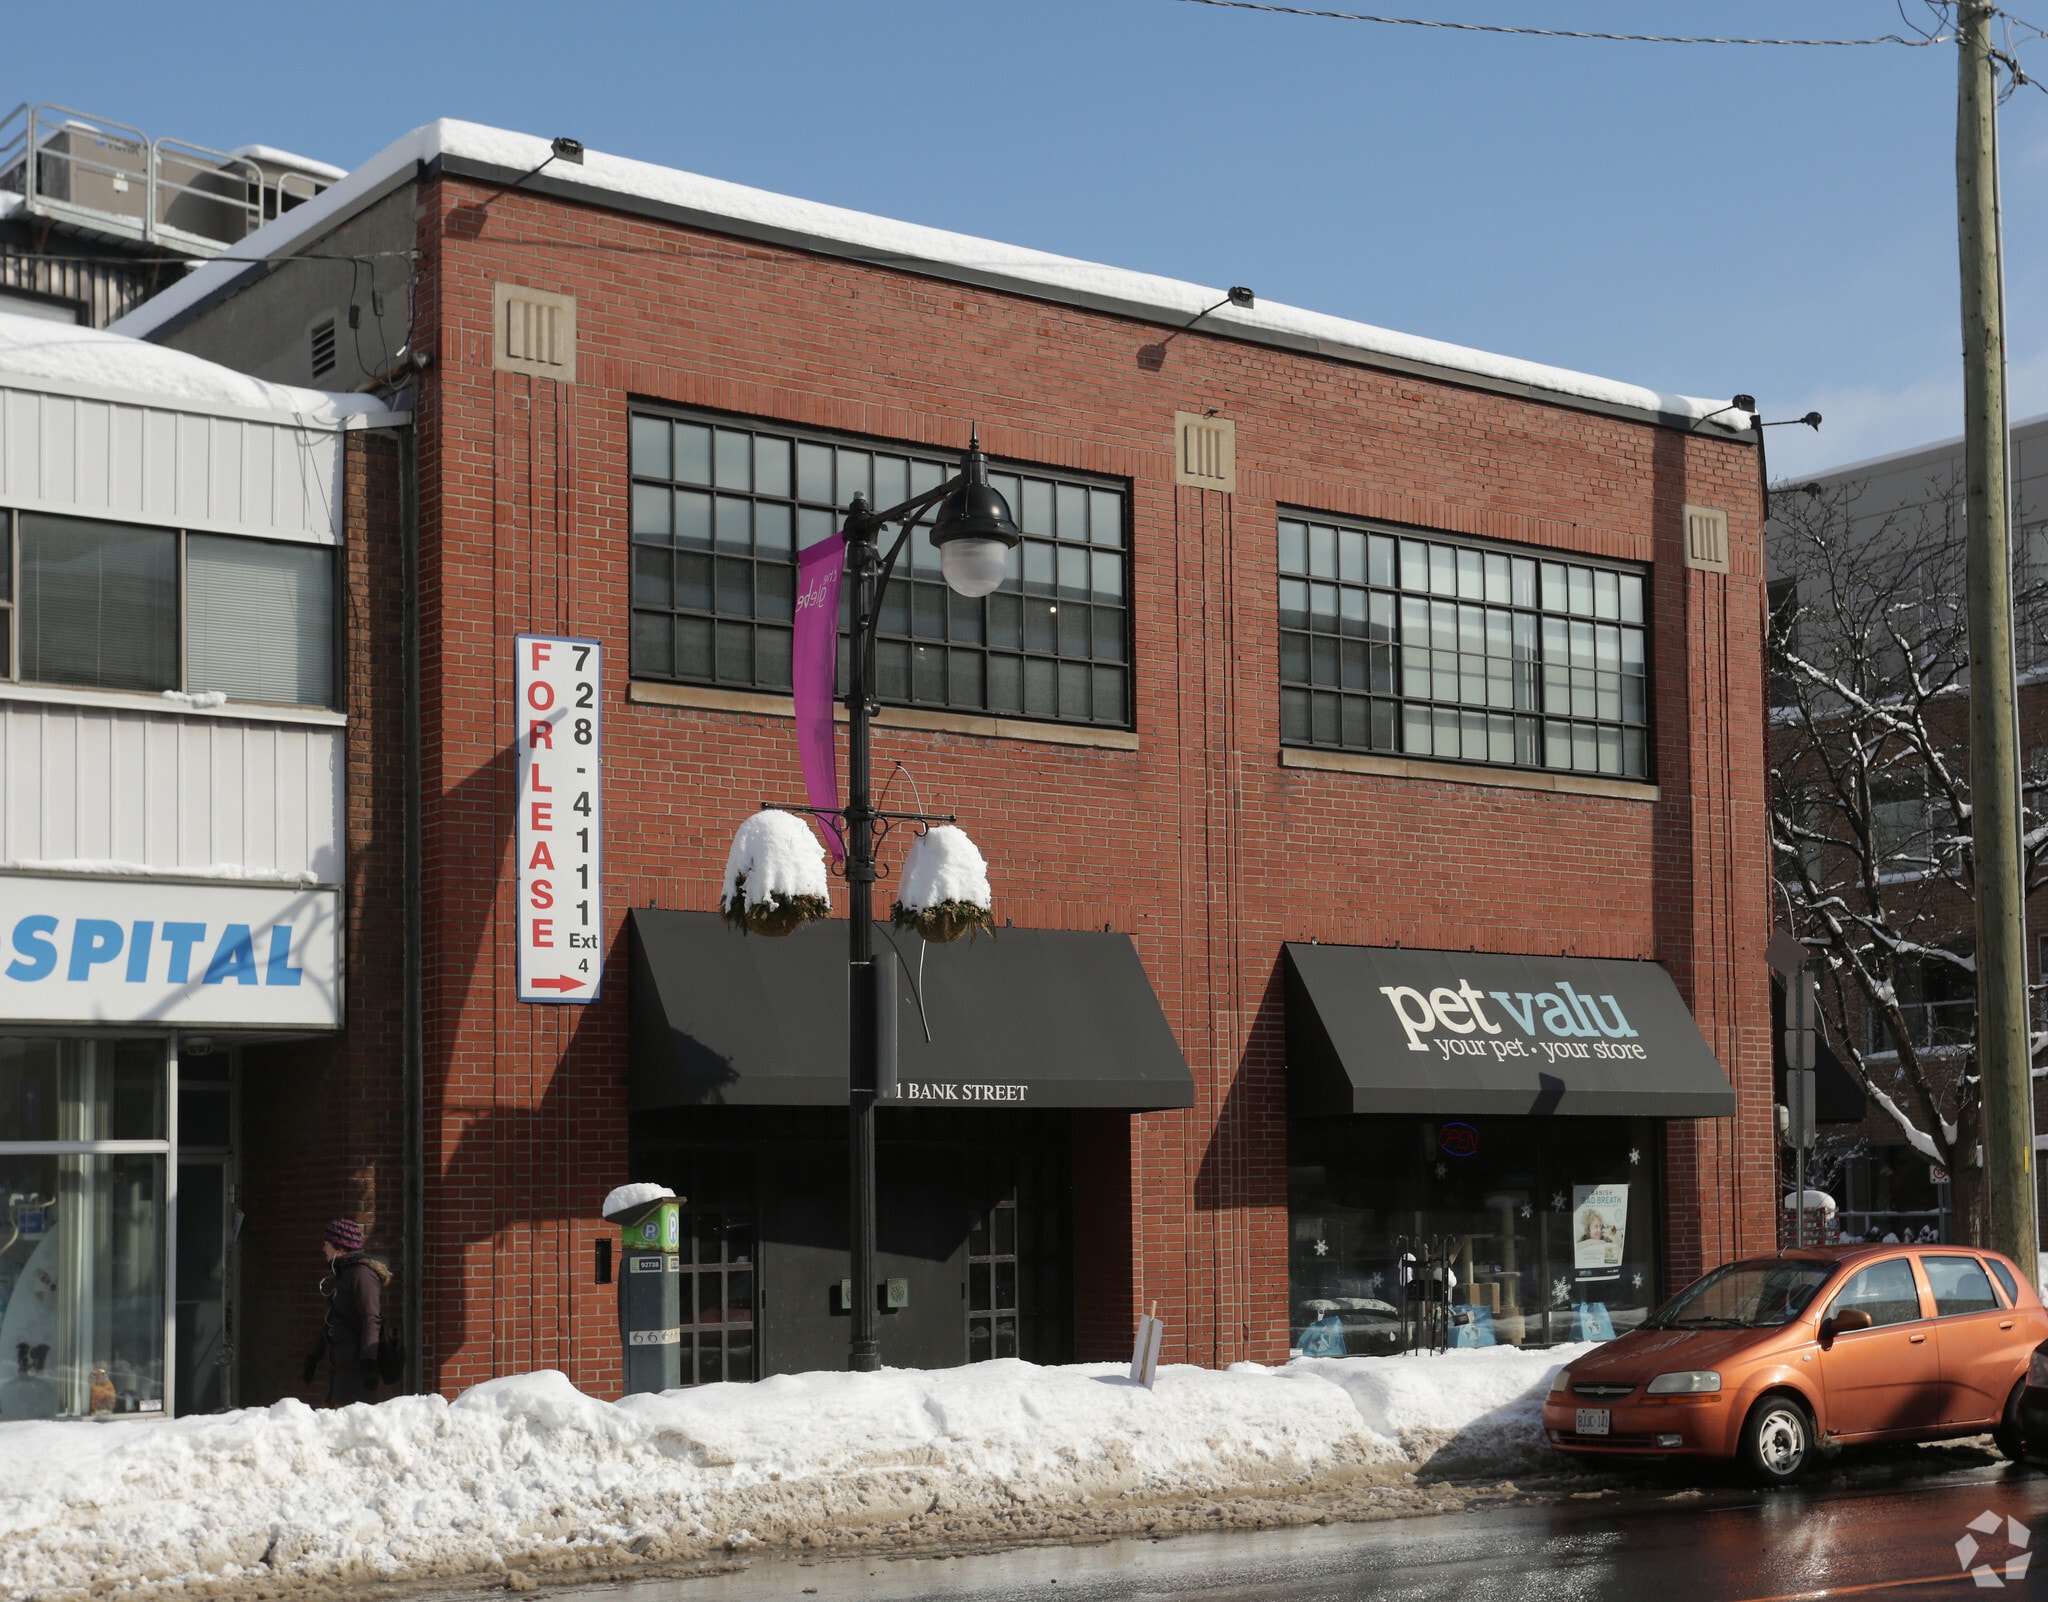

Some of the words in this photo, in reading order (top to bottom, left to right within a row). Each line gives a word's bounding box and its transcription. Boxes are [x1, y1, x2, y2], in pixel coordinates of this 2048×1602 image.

[0, 914, 303, 986] SPITAL
[569, 933, 598, 949] Ext
[578, 958, 589, 973] 4
[1434, 1038, 1487, 1061] your
[1489, 1037, 1529, 1062] pet
[1539, 1041, 1591, 1063] your
[1593, 1039, 1647, 1060] store
[908, 1083, 959, 1100] BANK
[962, 1084, 1028, 1101] STREET
[1439, 1128, 1479, 1150] OPEN
[1581, 1196, 1596, 1205] BAD
[1597, 1196, 1622, 1205] BREATH
